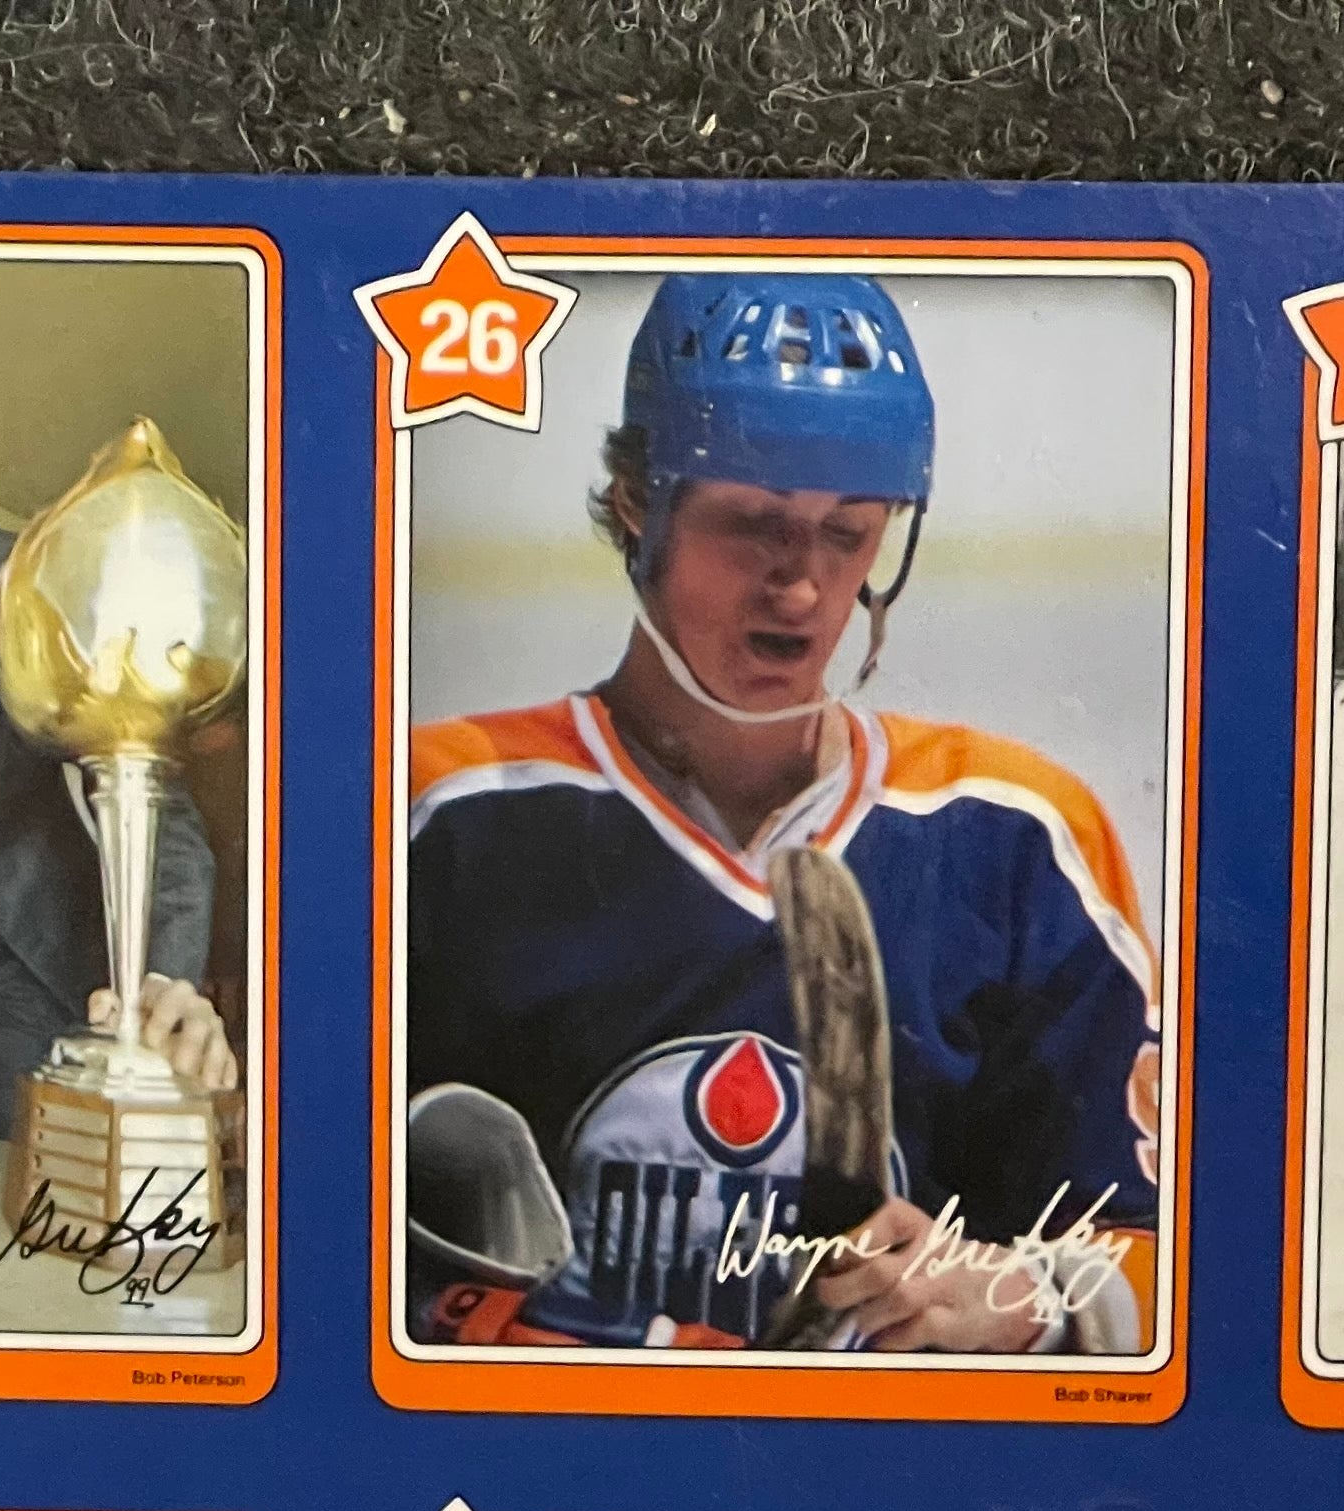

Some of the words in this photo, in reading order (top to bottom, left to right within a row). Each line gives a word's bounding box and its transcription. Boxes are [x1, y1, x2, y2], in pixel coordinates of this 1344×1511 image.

[419, 298, 519, 375] 26
[717, 1191, 891, 1294] Wayne
[132, 1369, 166, 1385] Bob
[171, 1370, 245, 1386] Peterson
[1055, 1386, 1089, 1402] Bob
